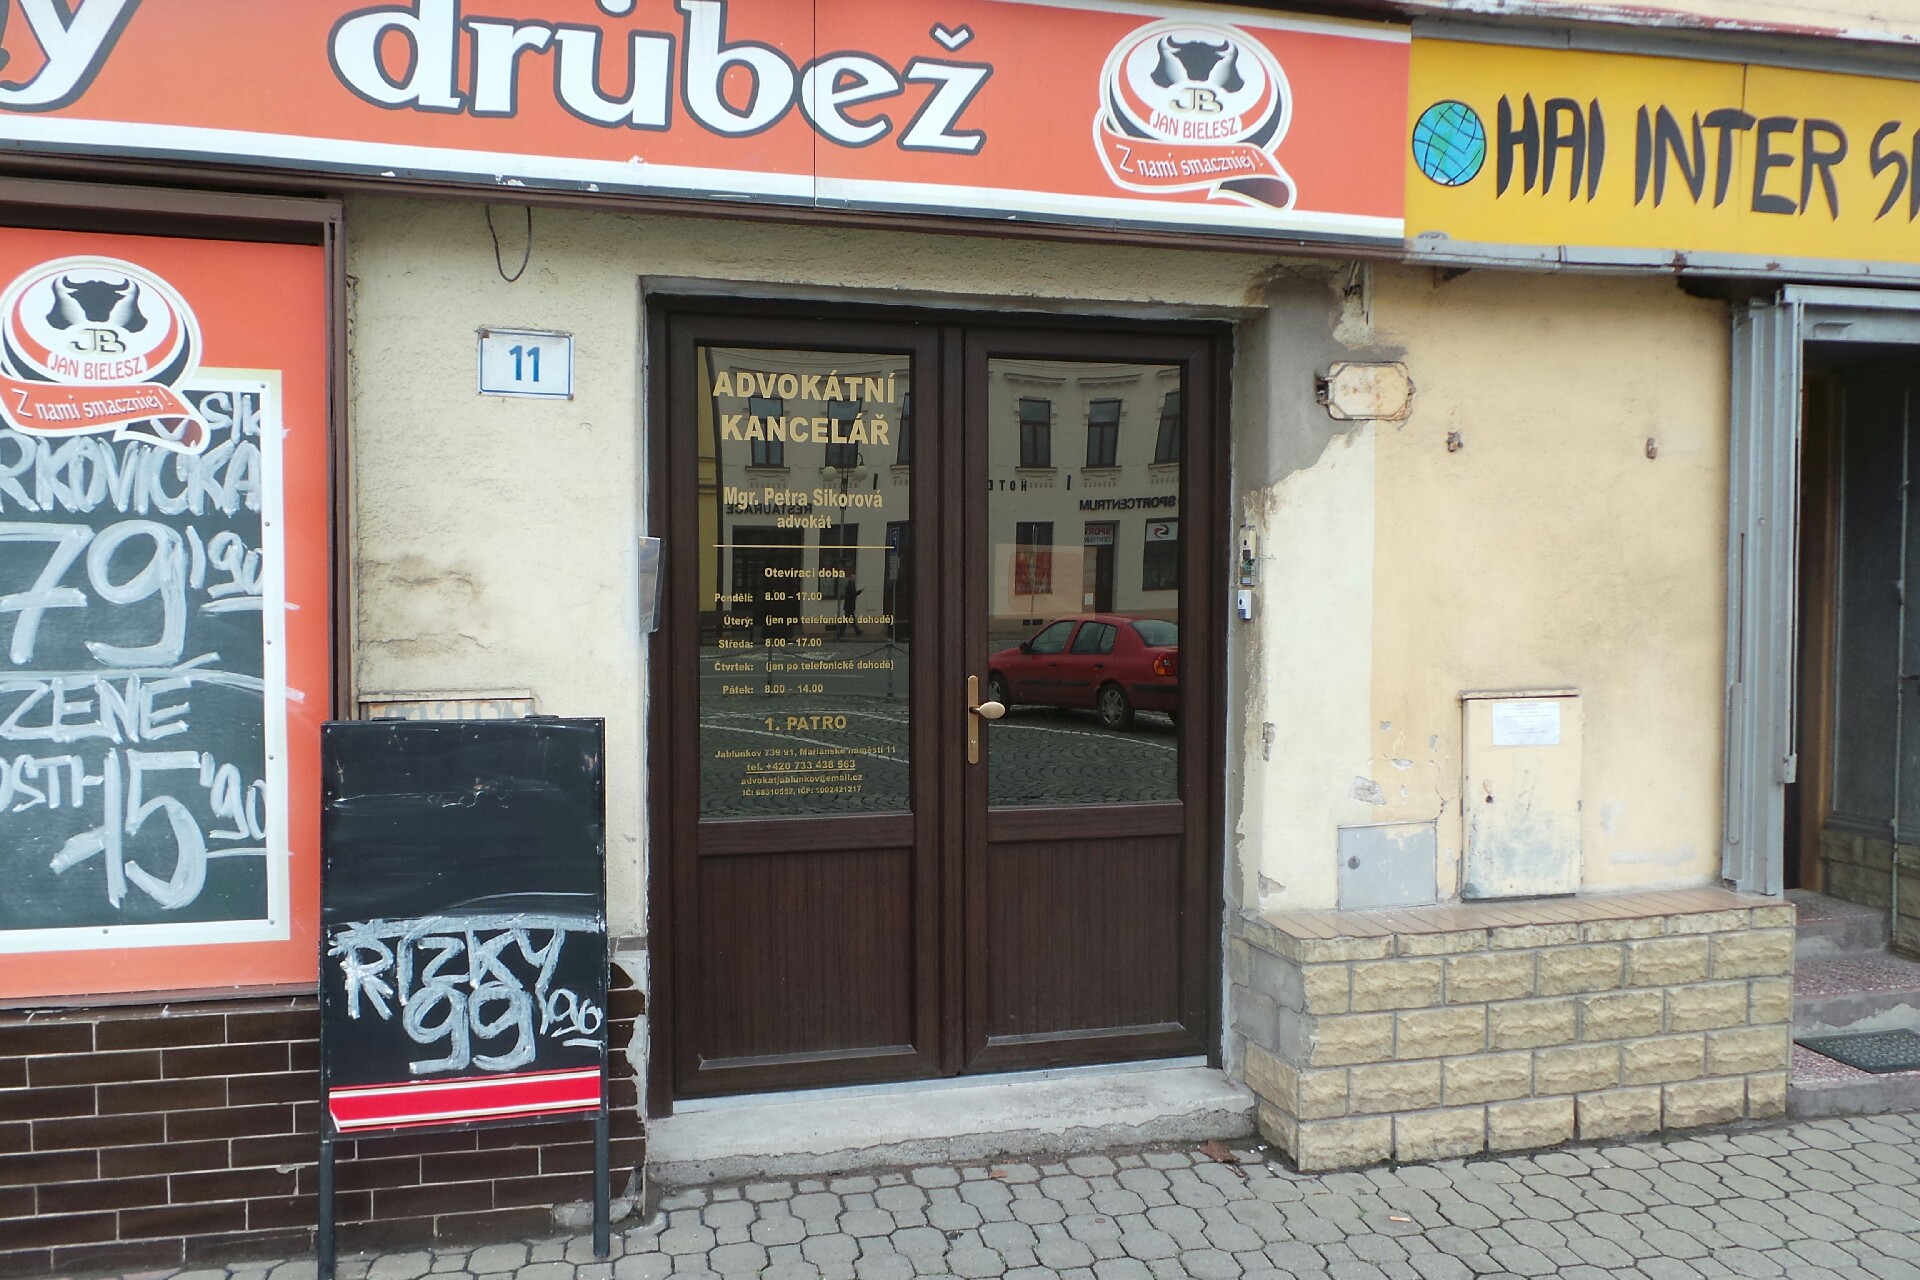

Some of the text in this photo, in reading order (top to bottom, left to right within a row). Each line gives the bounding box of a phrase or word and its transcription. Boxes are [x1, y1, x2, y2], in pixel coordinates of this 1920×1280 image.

[1169, 87, 1223, 115] JB
[1152, 113, 1239, 140] JAN BIELESZ
[1116, 144, 1135, 174] Z
[1137, 153, 1179, 178] nami
[1497, 92, 1605, 203] HAI
[1635, 104, 1848, 222] INTER
[67, 328, 126, 355] JB
[49, 354, 144, 381] JAN BIELESZ
[509, 345, 540, 382] 11
[713, 370, 895, 403] ADVOKÁTNÍ
[11, 388, 34, 418] Z
[35, 395, 81, 423] nami
[721, 413, 889, 445] KANCELÁŘ
[723, 486, 883, 510] Mgr. Petra Sikorová
[777, 515, 832, 529] advokát
[818, 567, 846, 579] doba
[714, 592, 753, 603] Pondělí:
[765, 592, 786, 601] 8.00
[796, 592, 822, 601] 17.00
[723, 614, 894, 628] Úterý: (jen po telefonické dohodě)
[718, 639, 753, 649] Středa:
[765, 638, 786, 648] 8.00
[796, 638, 822, 648] 17.00
[714, 661, 754, 671] Čtvrtek:
[765, 661, 785, 672] (jen
[787, 662, 798, 672] po
[801, 660, 854, 671] telefonické
[722, 685, 754, 695] Pátek:
[765, 684, 785, 694] 8.00
[797, 684, 823, 694] 14.00
[764, 715, 847, 731] 1. PATRO
[714, 750, 762, 759] Jablunkov
[764, 749, 781, 758] 739
[746, 762, 763, 772] tel.
[766, 761, 791, 771] +420
[794, 760, 812, 770] 733
[815, 759, 834, 769] 438
